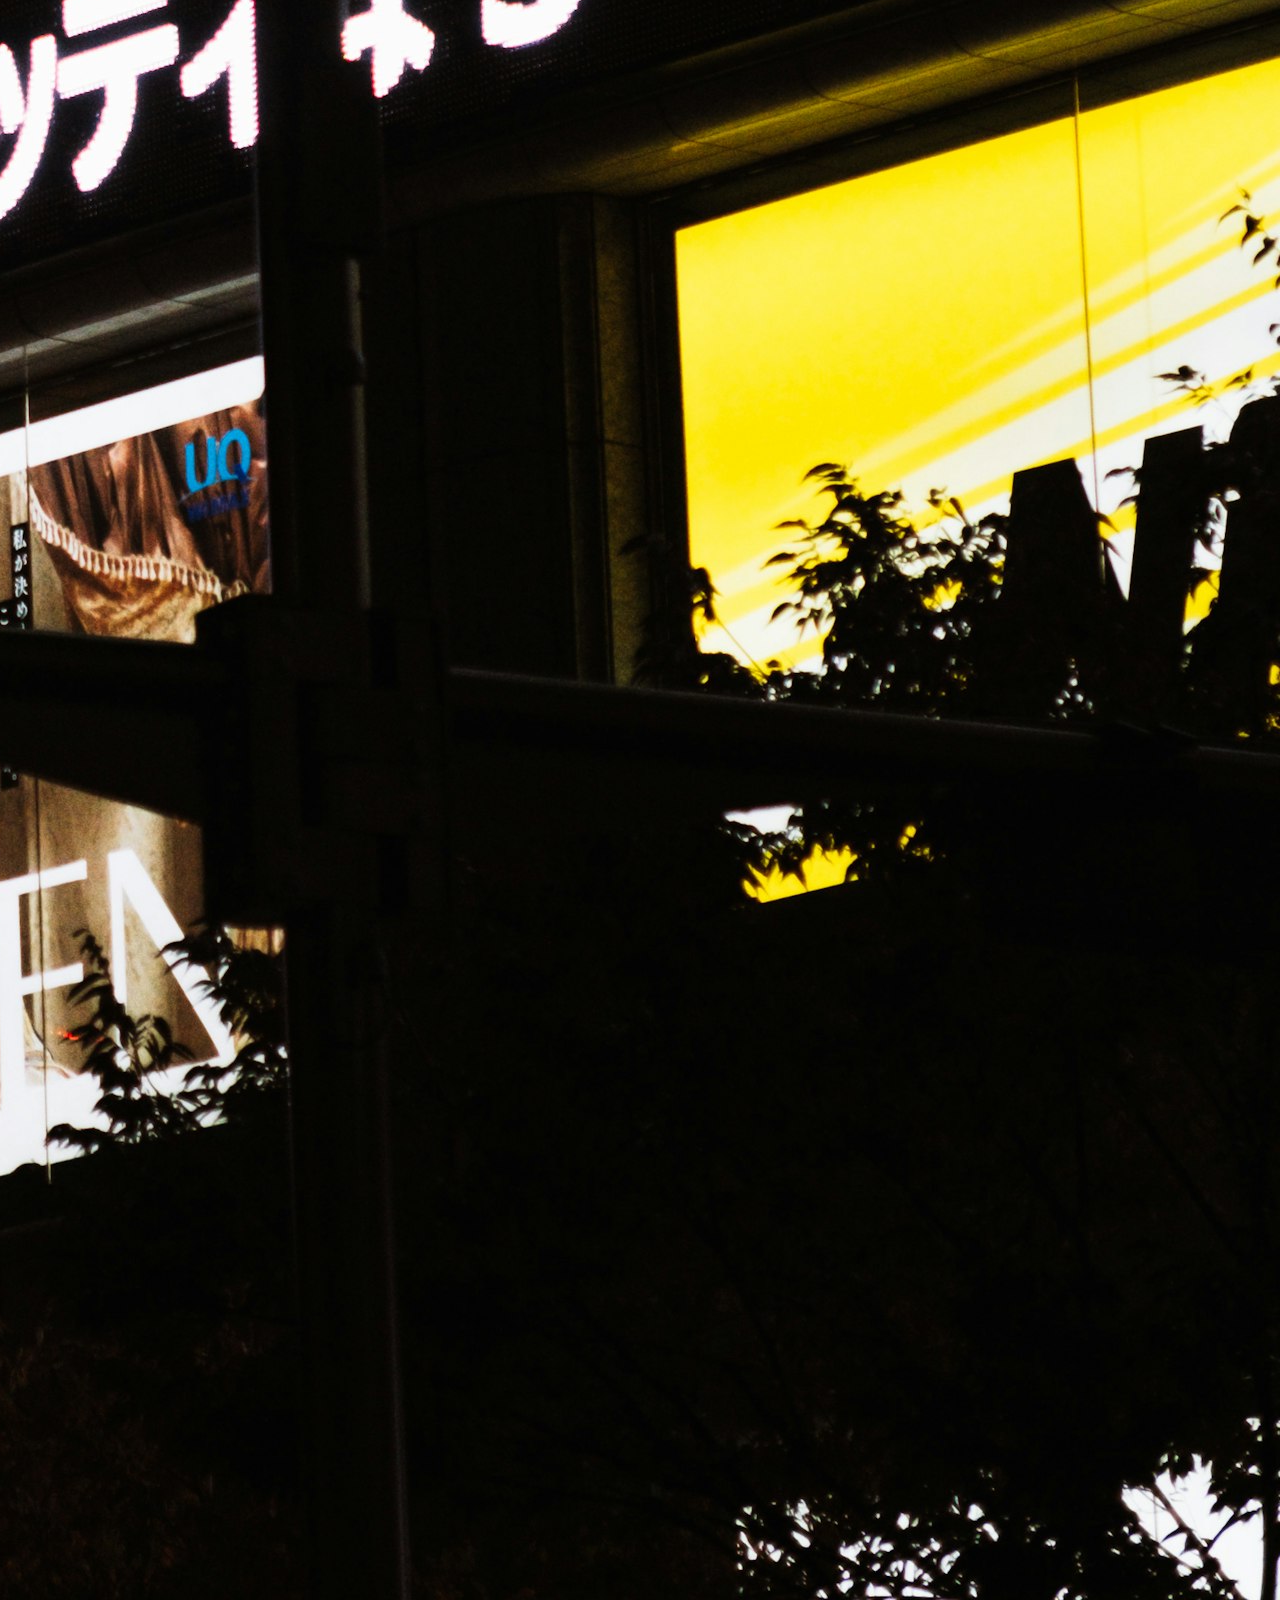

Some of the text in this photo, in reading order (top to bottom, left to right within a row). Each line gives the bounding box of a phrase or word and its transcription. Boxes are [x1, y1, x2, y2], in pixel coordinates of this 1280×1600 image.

[184, 428, 252, 494] UQ
[12, 527, 29, 630] 私が決め
